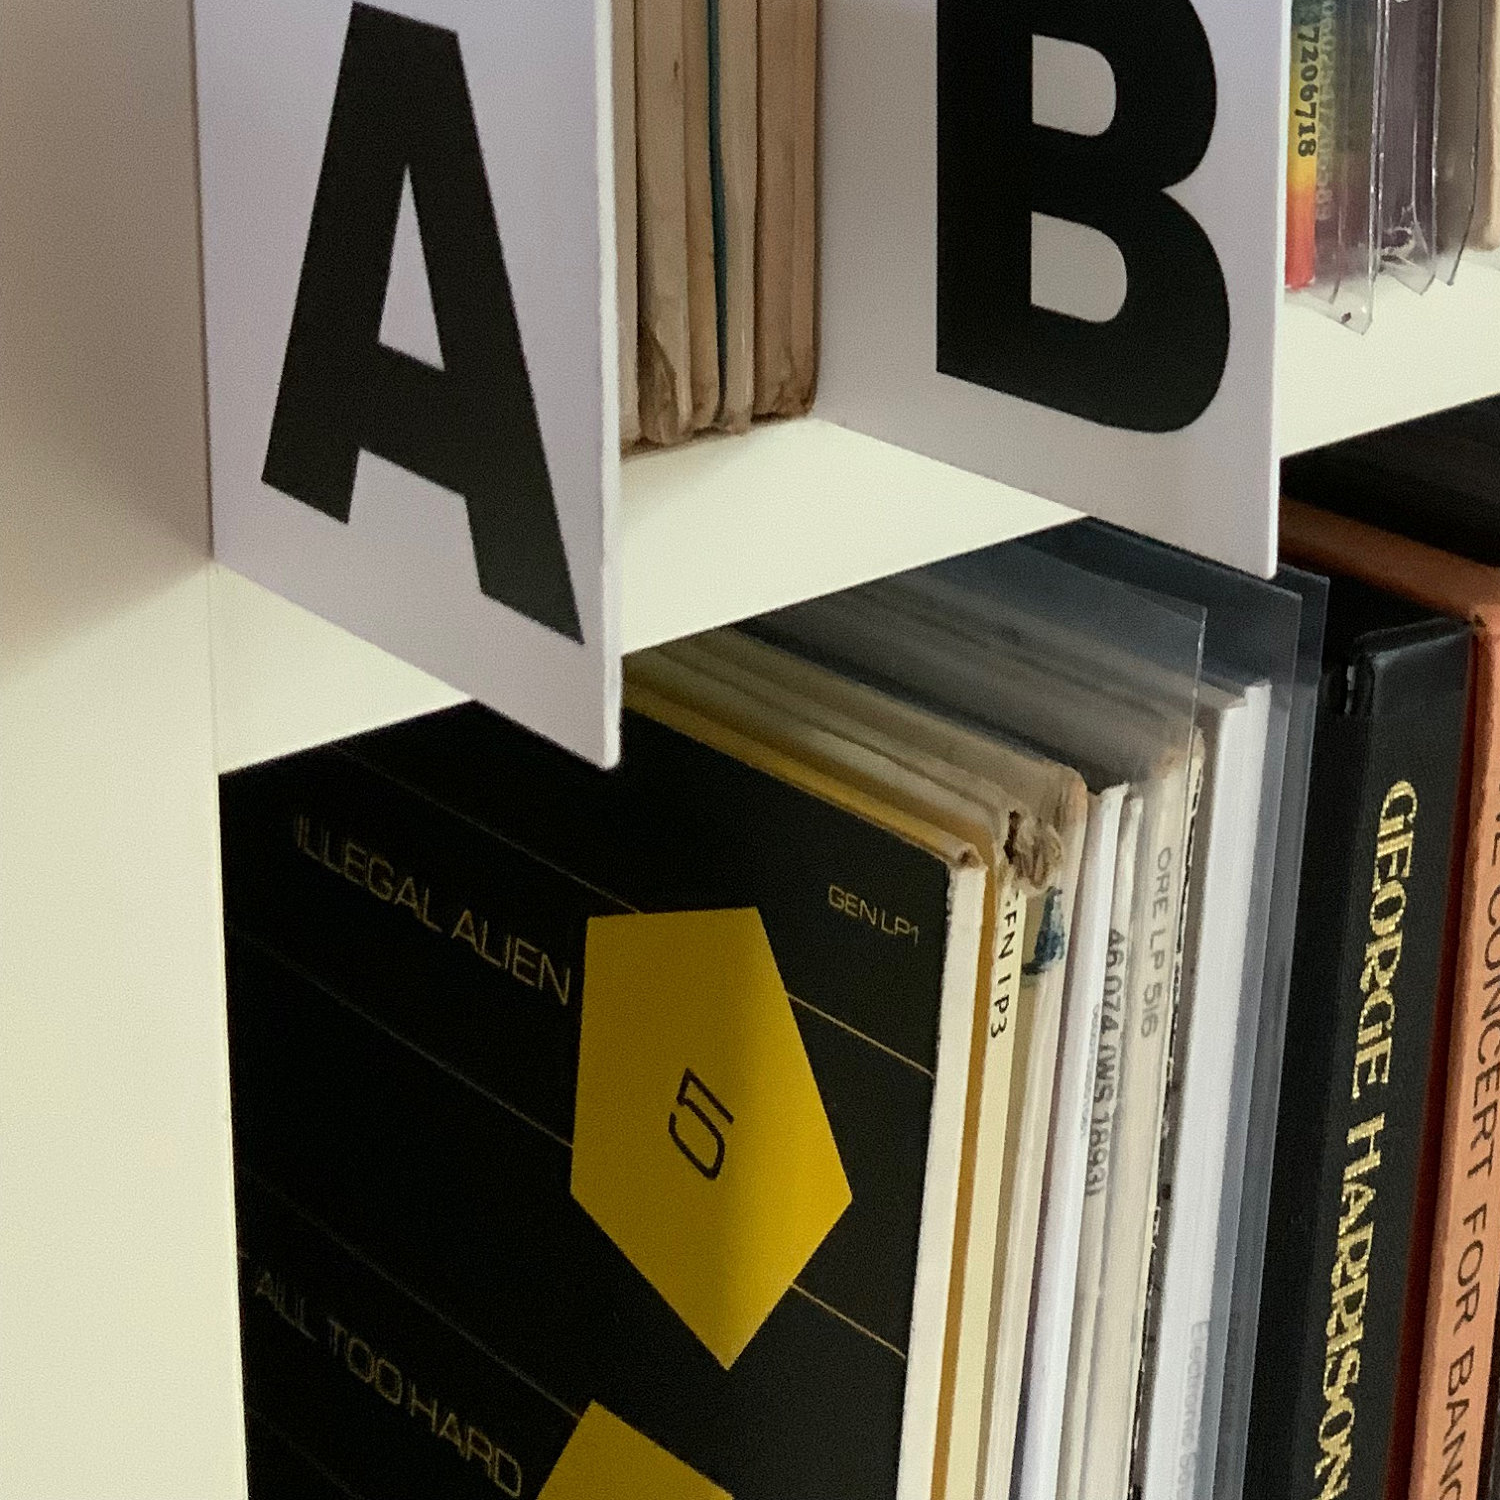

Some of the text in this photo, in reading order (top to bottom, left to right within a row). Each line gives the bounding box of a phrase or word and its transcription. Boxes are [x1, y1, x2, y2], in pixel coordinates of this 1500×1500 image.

[261, 1, 585, 645] A
[297, 814, 571, 1006] ILLEGAL ALIEN
[1150, 929, 1166, 970] LP
[668, 1067, 735, 1181] 5
[1312, 781, 1417, 1500] GEORGE HARRISON
[1453, 1203, 1488, 1334] FOR
[256, 1271, 521, 1498] ALL TOO HARD
